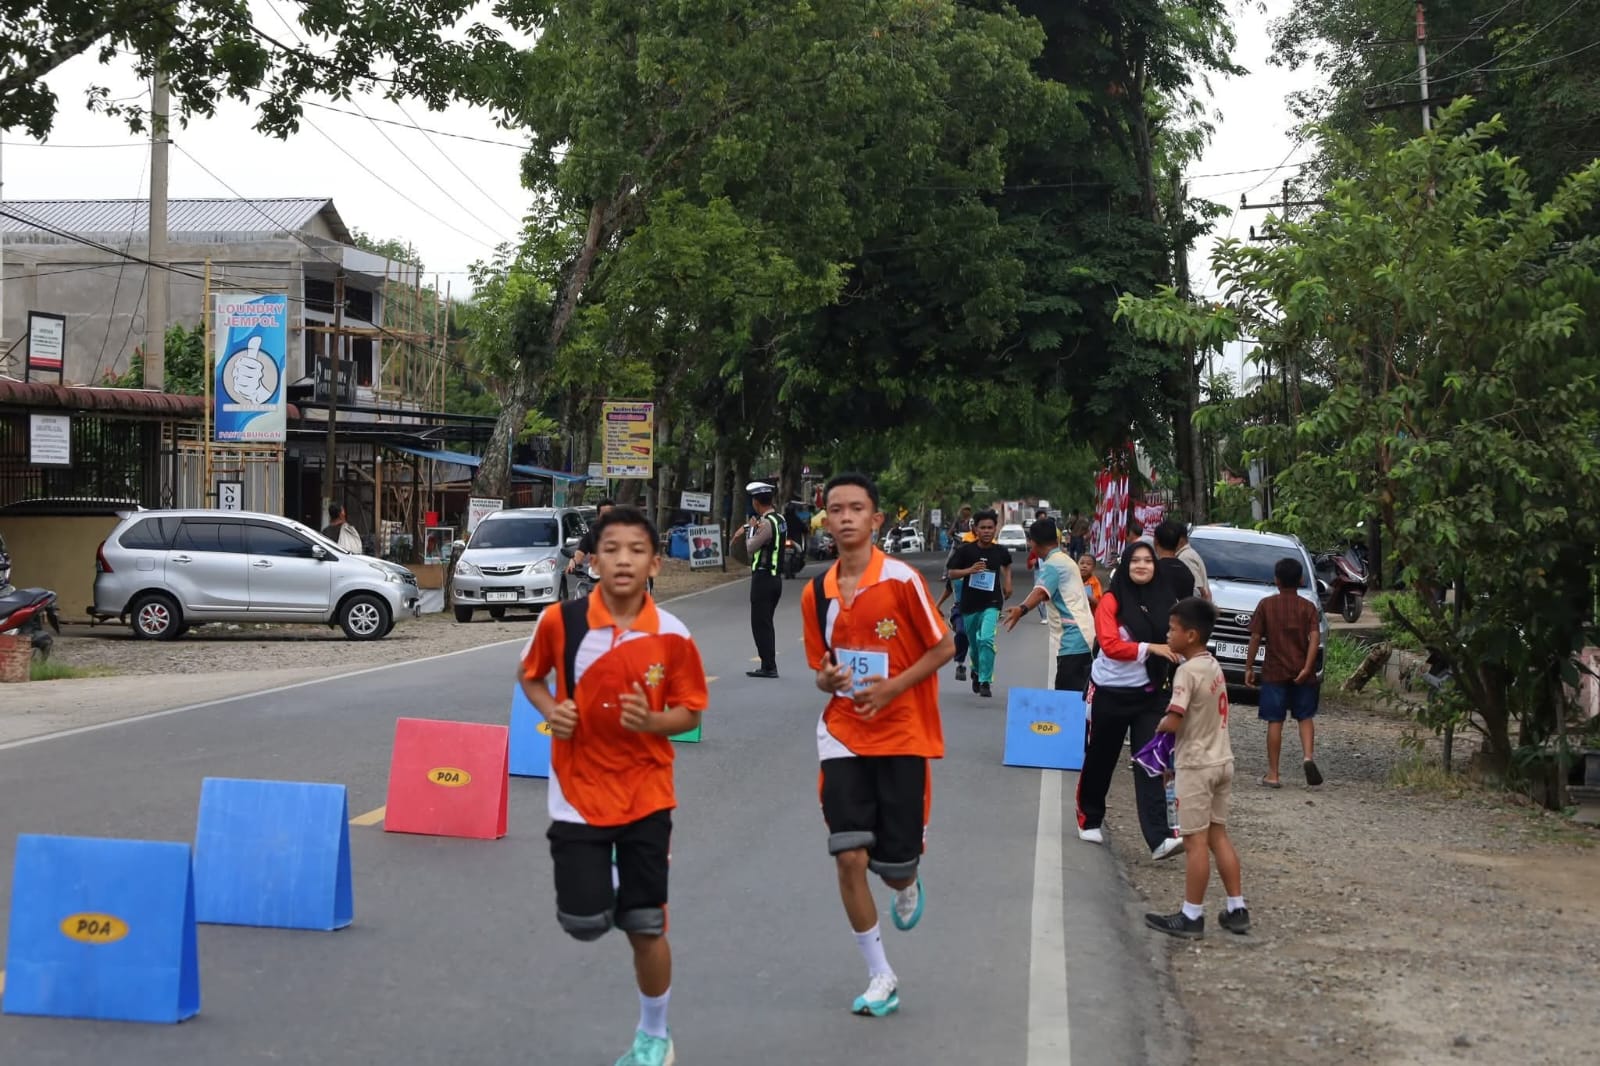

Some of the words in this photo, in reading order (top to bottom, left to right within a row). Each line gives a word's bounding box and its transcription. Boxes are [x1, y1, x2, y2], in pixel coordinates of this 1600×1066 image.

[218, 303, 285, 314] LOUNDRY
[224, 316, 279, 327] JEMPOL
[1217, 643, 1226, 653] BB
[849, 656, 869, 675] 45
[1218, 691, 1229, 728] 9
[437, 772, 459, 782] POA
[76, 919, 111, 936] POA
